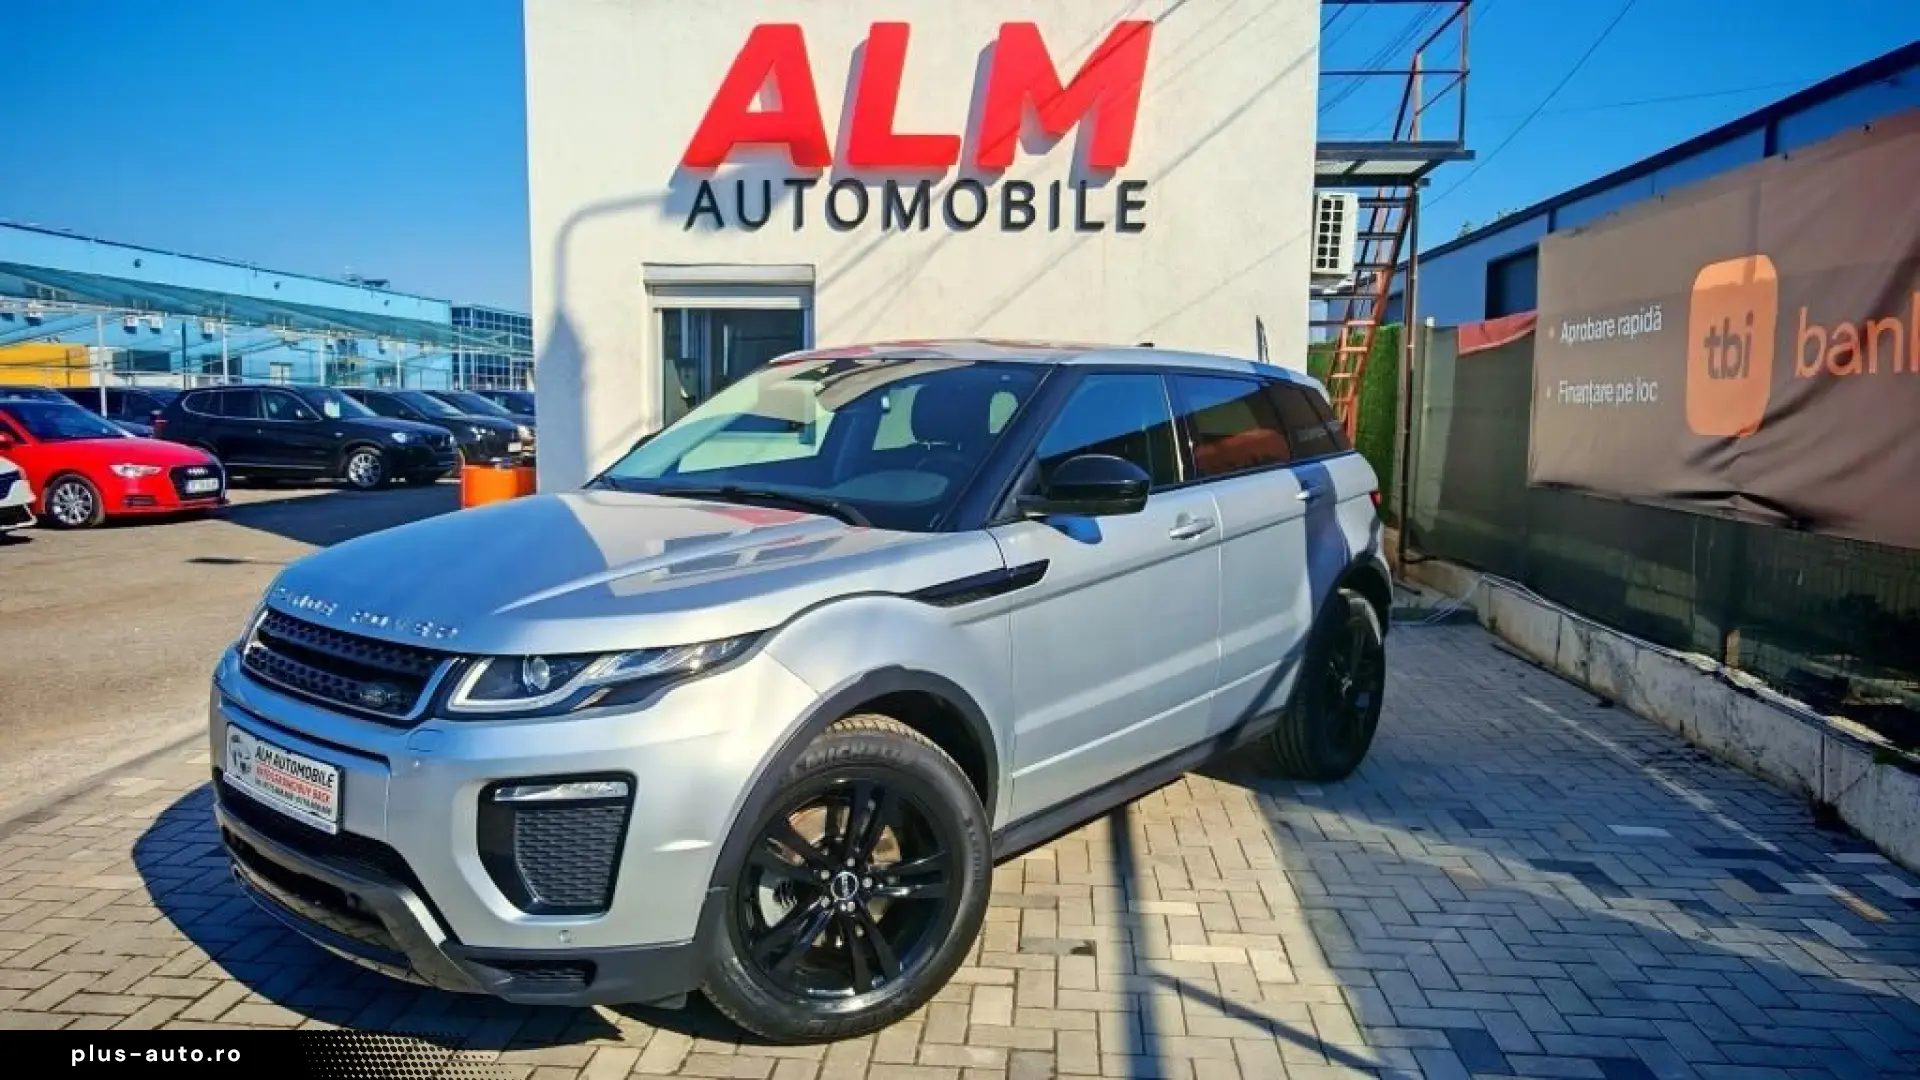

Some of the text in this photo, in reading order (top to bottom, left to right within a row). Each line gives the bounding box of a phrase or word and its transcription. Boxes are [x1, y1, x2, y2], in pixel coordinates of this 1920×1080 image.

[682, 19, 1154, 168] ALM
[684, 177, 1148, 232] AUTOMOBILE
[1561, 303, 1662, 347] Aprobare rapidă
[1704, 309, 1755, 380] tbi
[1615, 382, 1634, 406] pe
[1636, 376, 1659, 403] loc
[255, 745, 273, 765] ALM
[274, 753, 335, 788] AUTOMOBILE
